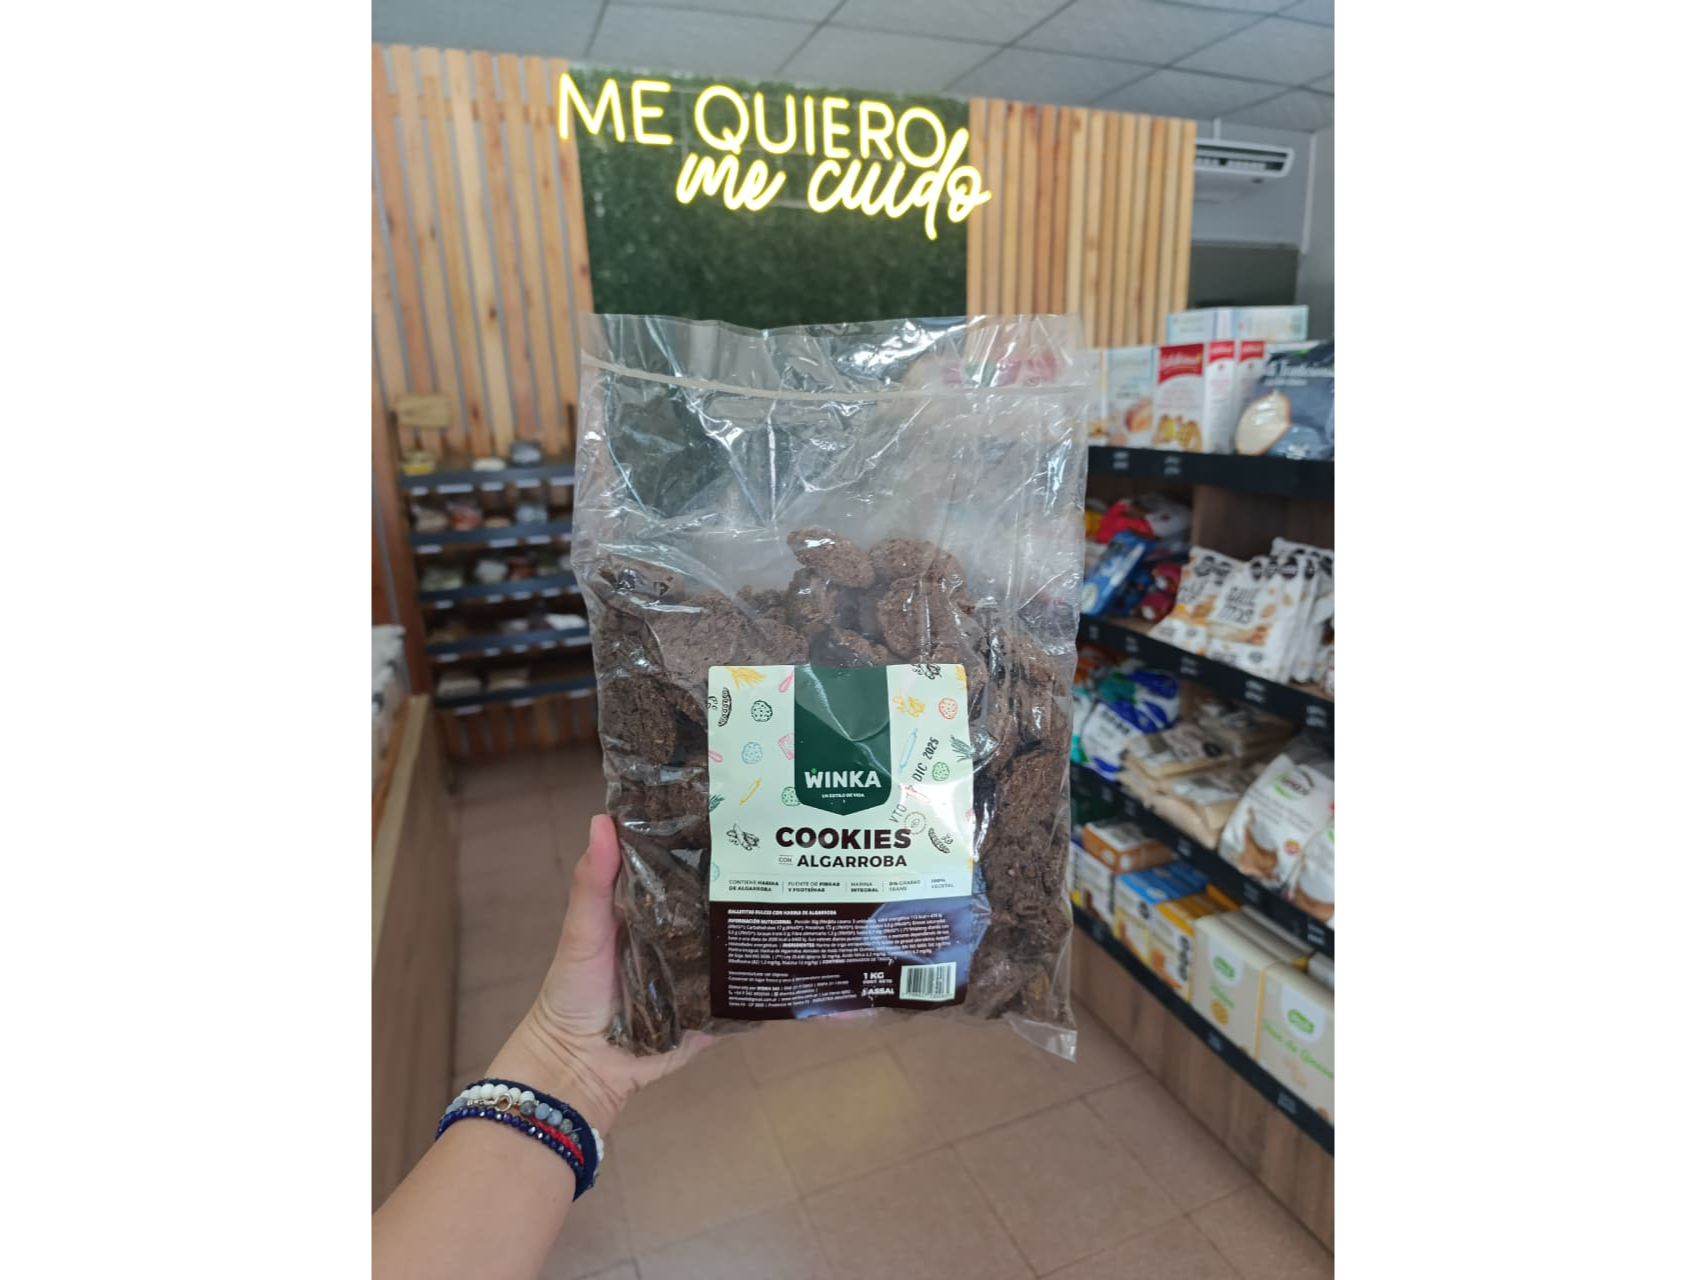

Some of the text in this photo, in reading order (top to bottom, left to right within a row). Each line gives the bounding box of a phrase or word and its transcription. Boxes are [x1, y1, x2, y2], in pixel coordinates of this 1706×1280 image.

[557, 73, 947, 169] ME QUIERO
[676, 128, 993, 241] me cuido
[803, 769, 882, 789] WINKA
[888, 736, 940, 824] VTO DIC 2025
[775, 826, 912, 850] COOKIES
[796, 855, 908, 868] ALGARROBA
